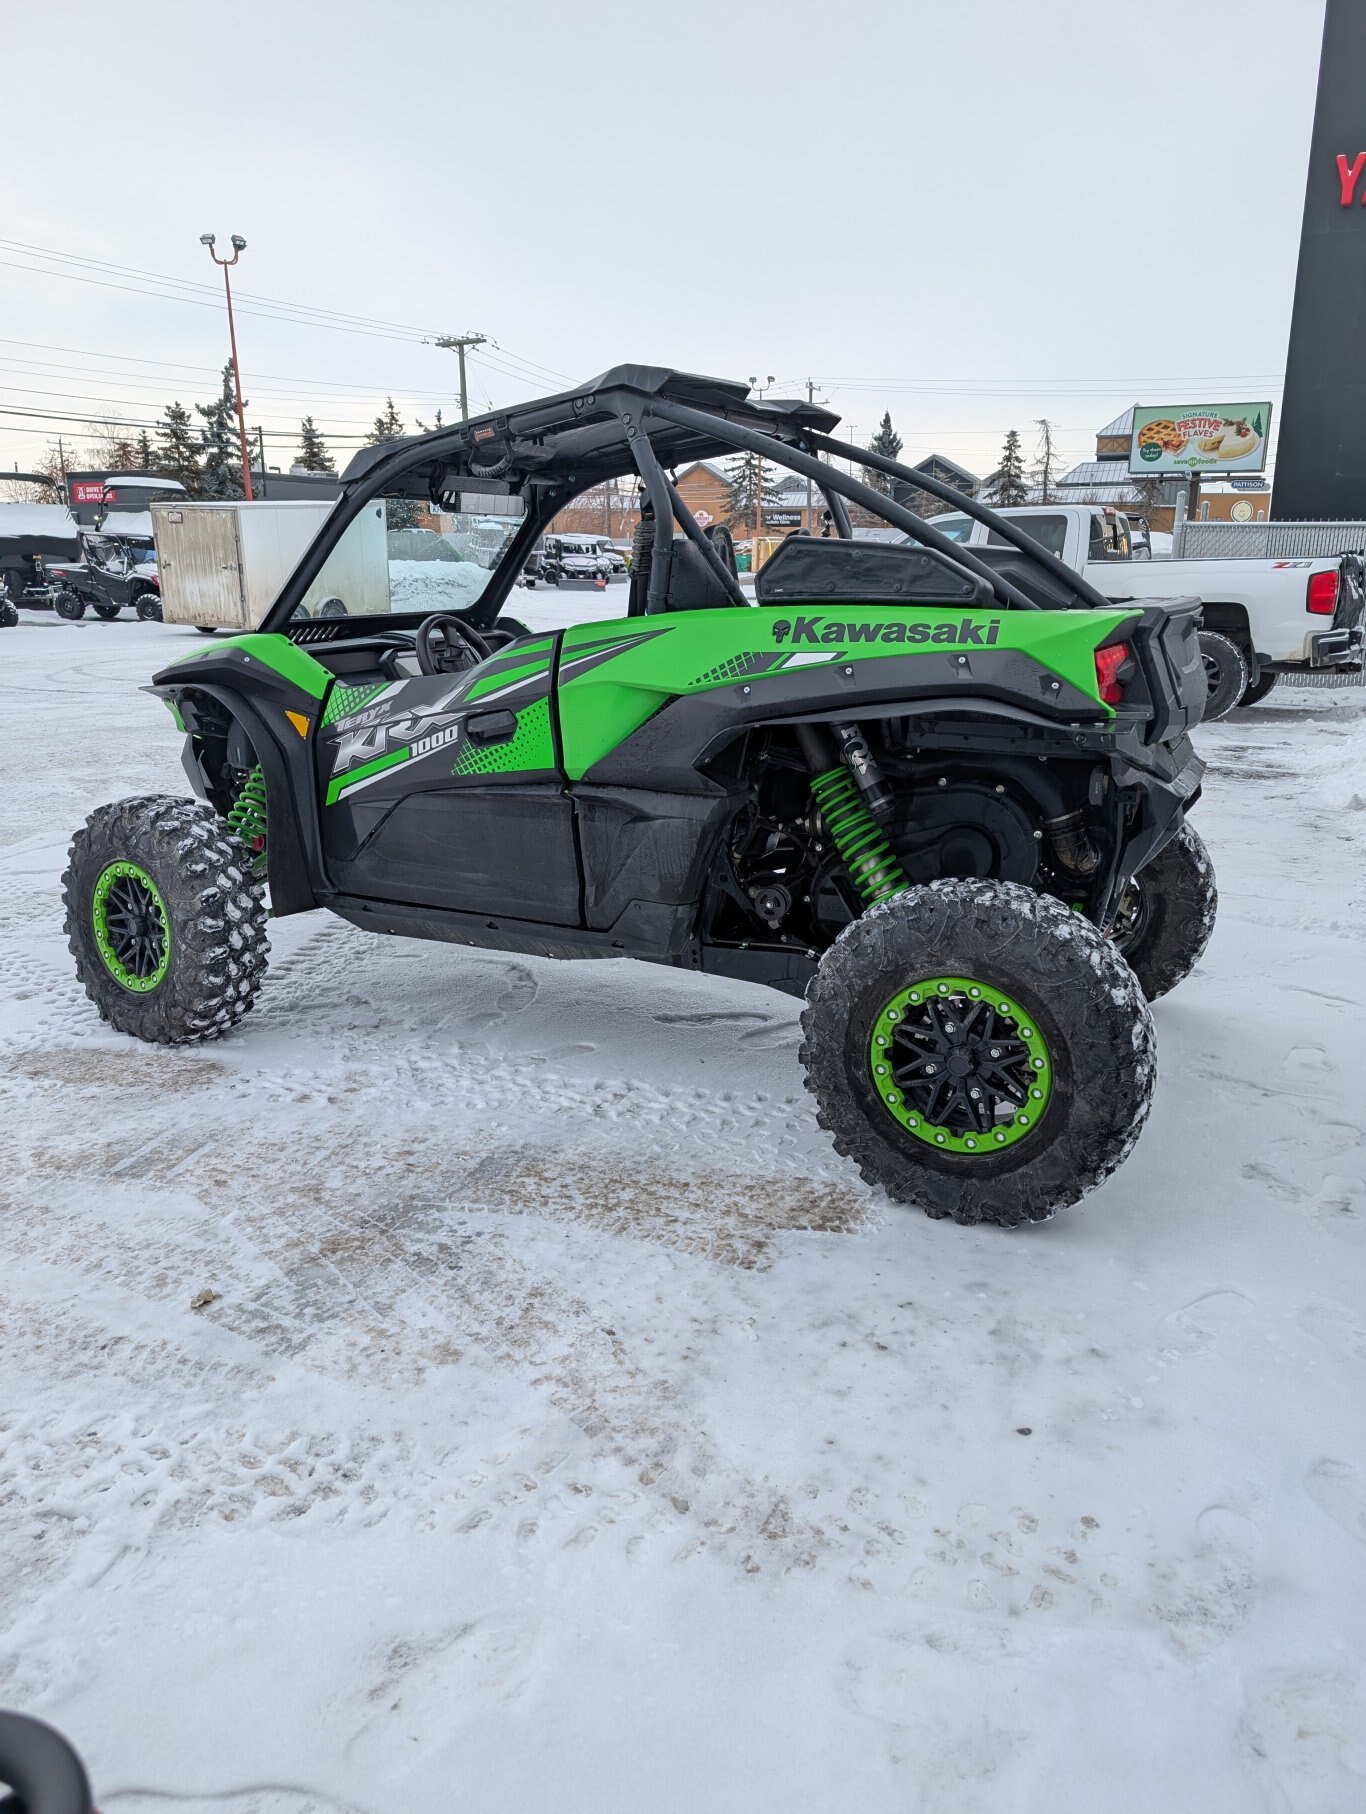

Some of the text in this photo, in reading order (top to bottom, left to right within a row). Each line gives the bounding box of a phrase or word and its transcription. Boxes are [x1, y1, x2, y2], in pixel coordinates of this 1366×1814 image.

[1335, 151, 1366, 208] Y
[1175, 417, 1222, 432] FESTIVE
[1181, 411, 1219, 419] SIGNATURE
[1182, 430, 1215, 438] FLAVES
[772, 513, 801, 521] Wellness
[1271, 561, 1314, 569] Z71
[791, 616, 1001, 645] Kawasaki
[326, 680, 476, 775] KRX
[334, 700, 394, 732] TERYX
[410, 725, 459, 757] 1000
[840, 726, 878, 775] FOX
